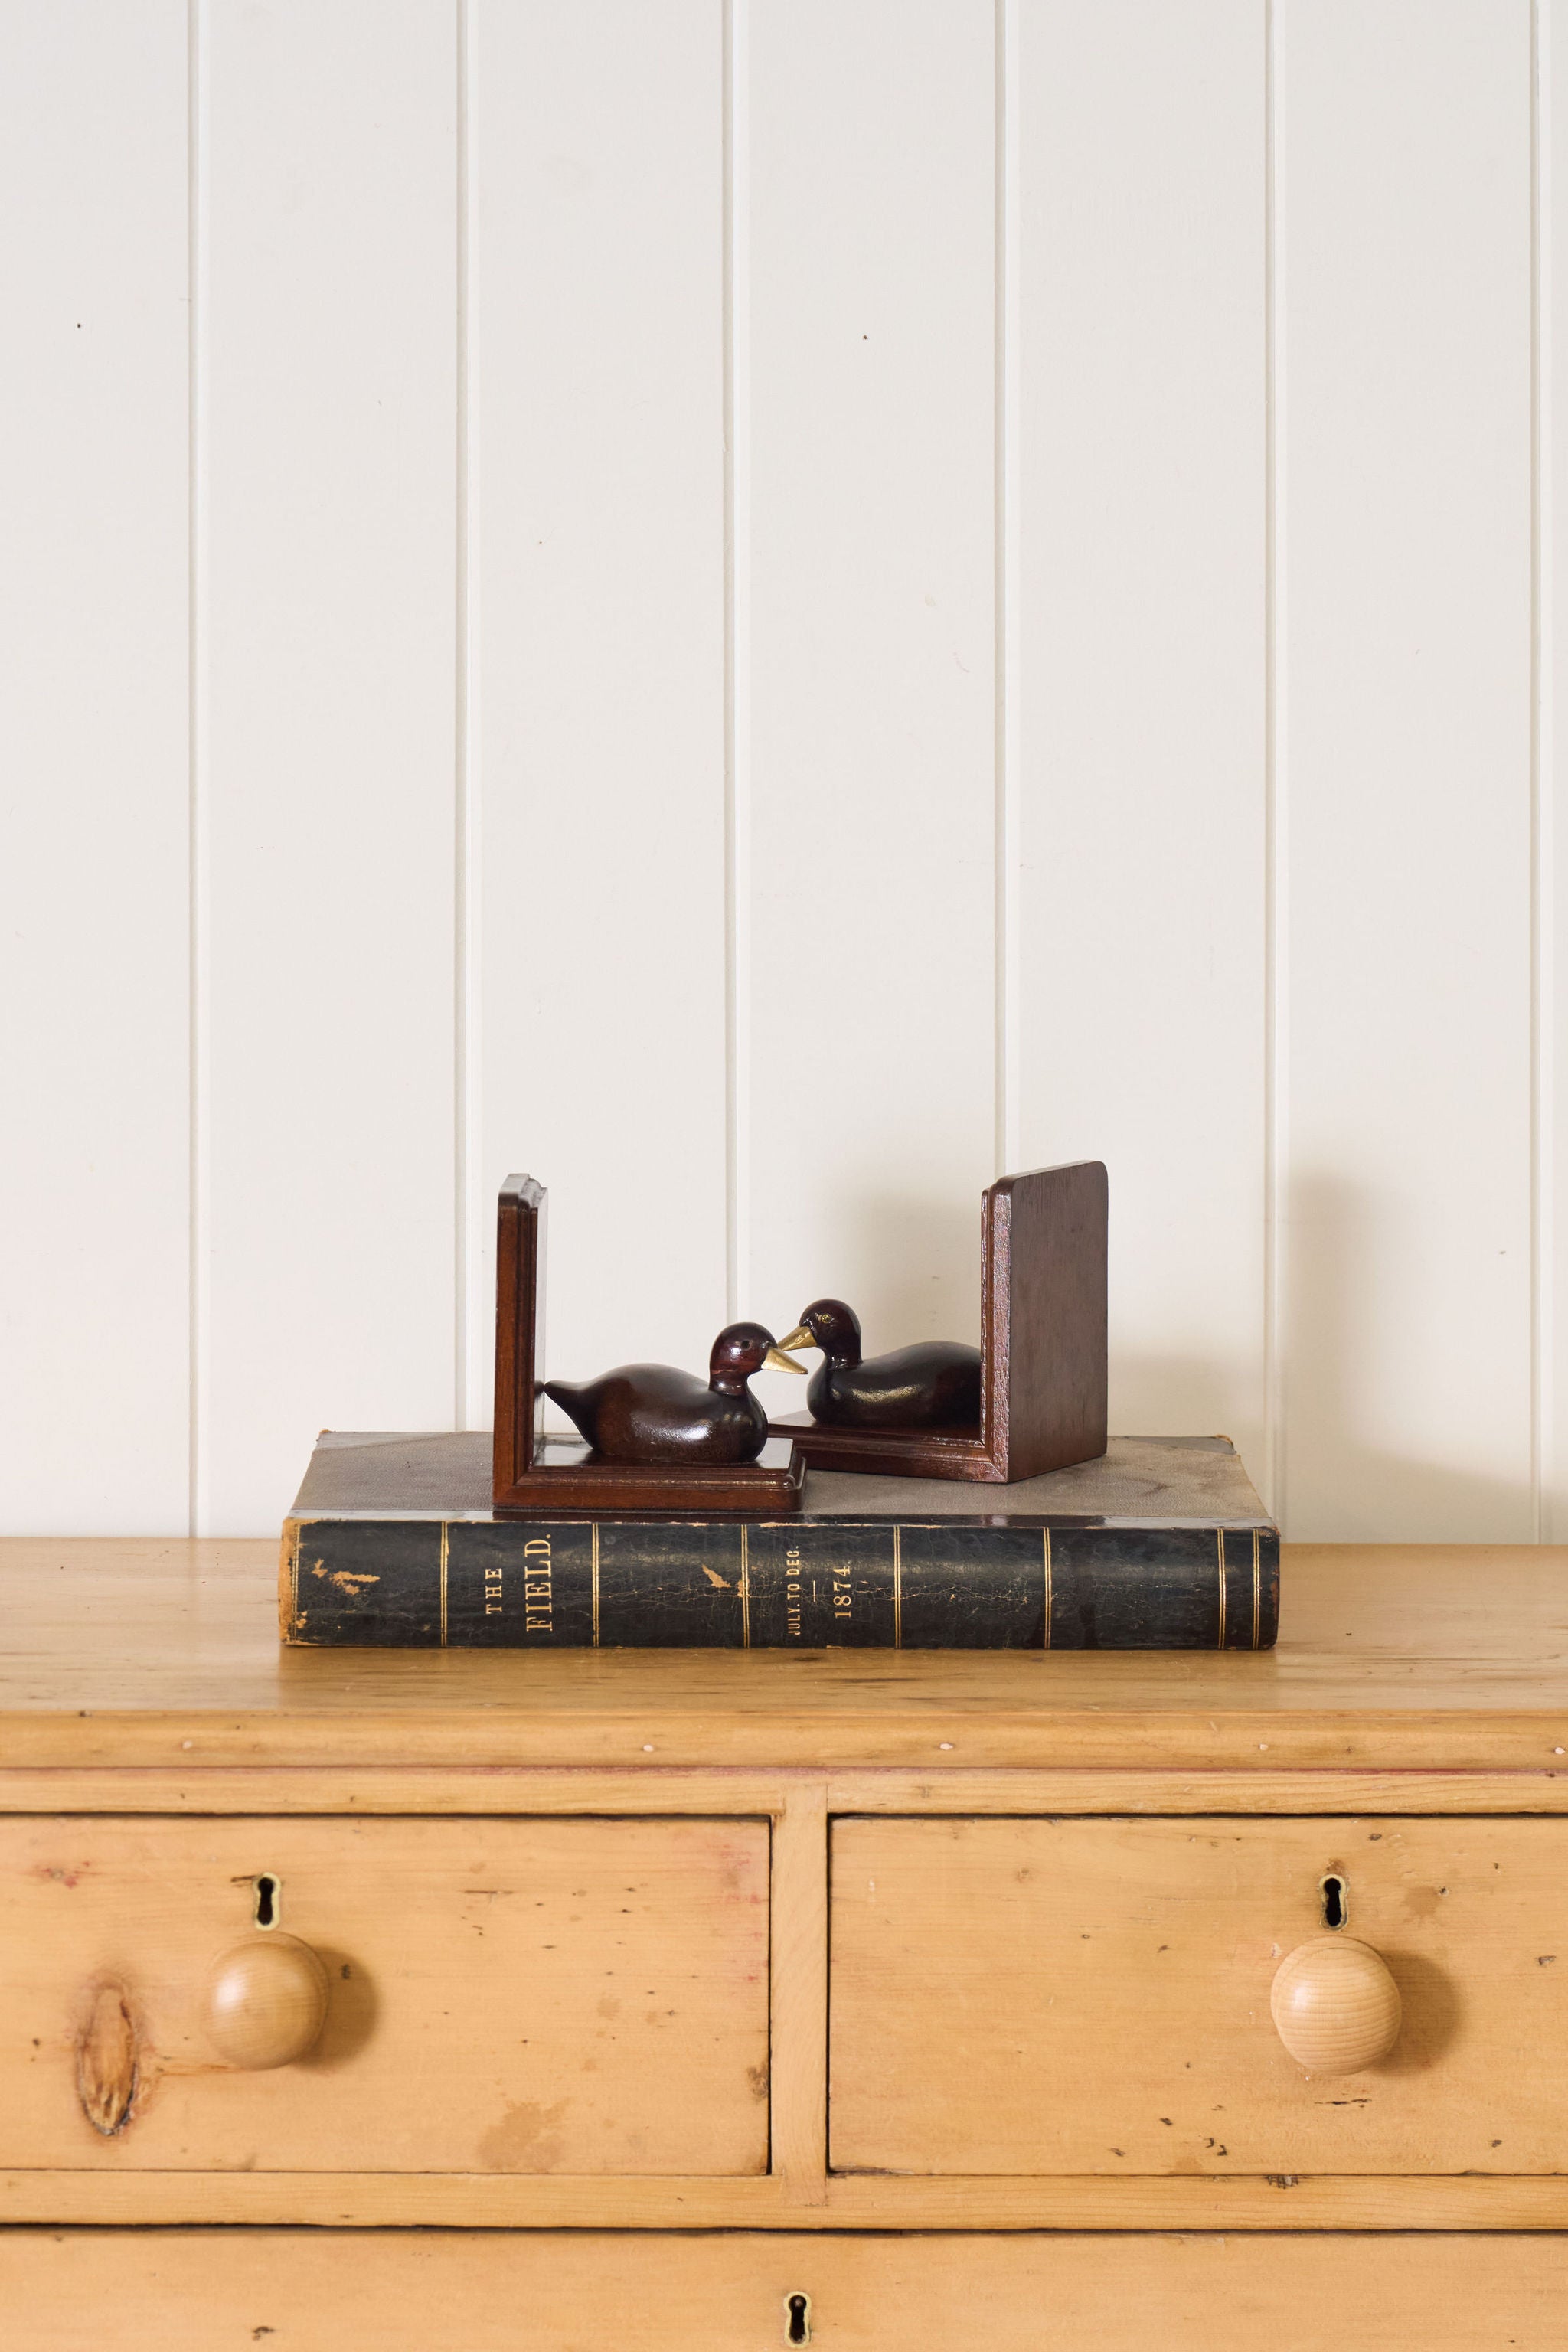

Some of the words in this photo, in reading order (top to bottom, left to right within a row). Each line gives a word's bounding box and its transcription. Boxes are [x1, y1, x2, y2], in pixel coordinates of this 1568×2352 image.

[485, 1568, 502, 1615] THE
[524, 1534, 552, 1632] FIELD.
[787, 1583, 800, 1600] TO
